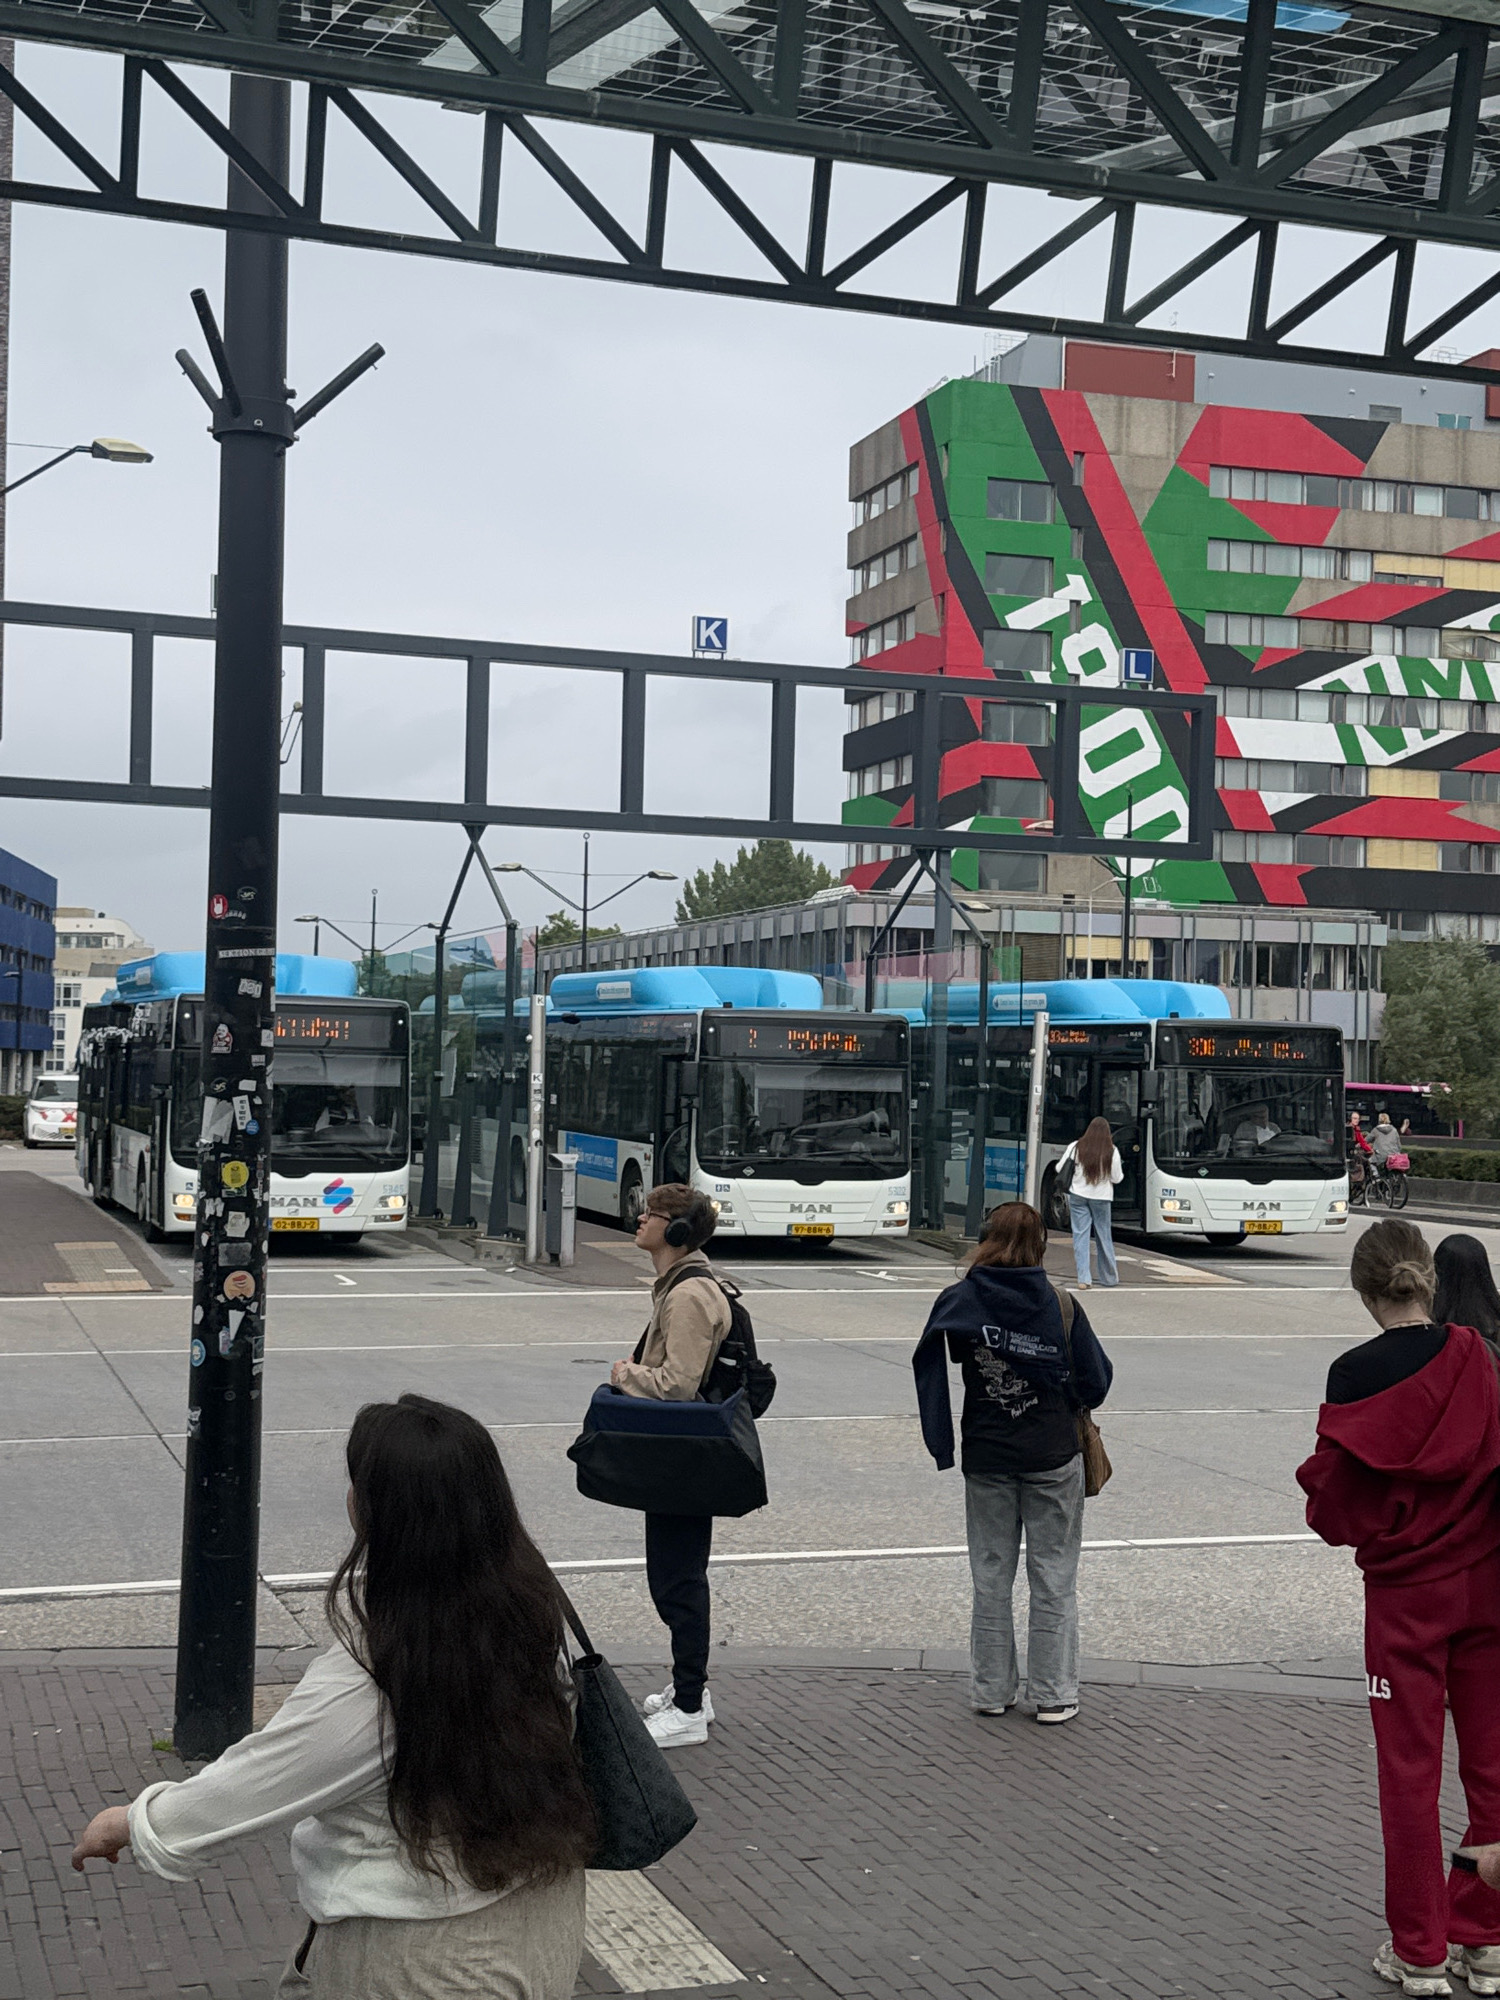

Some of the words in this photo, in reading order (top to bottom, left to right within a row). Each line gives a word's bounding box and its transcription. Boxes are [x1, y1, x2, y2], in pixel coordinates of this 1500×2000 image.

[700, 619, 723, 648] K
[1130, 652, 1147, 679] L
[533, 1074, 541, 1082] K
[271, 1197, 318, 1207] MAN
[1242, 1201, 1281, 1211] MAN
[790, 1203, 832, 1213] MAN
